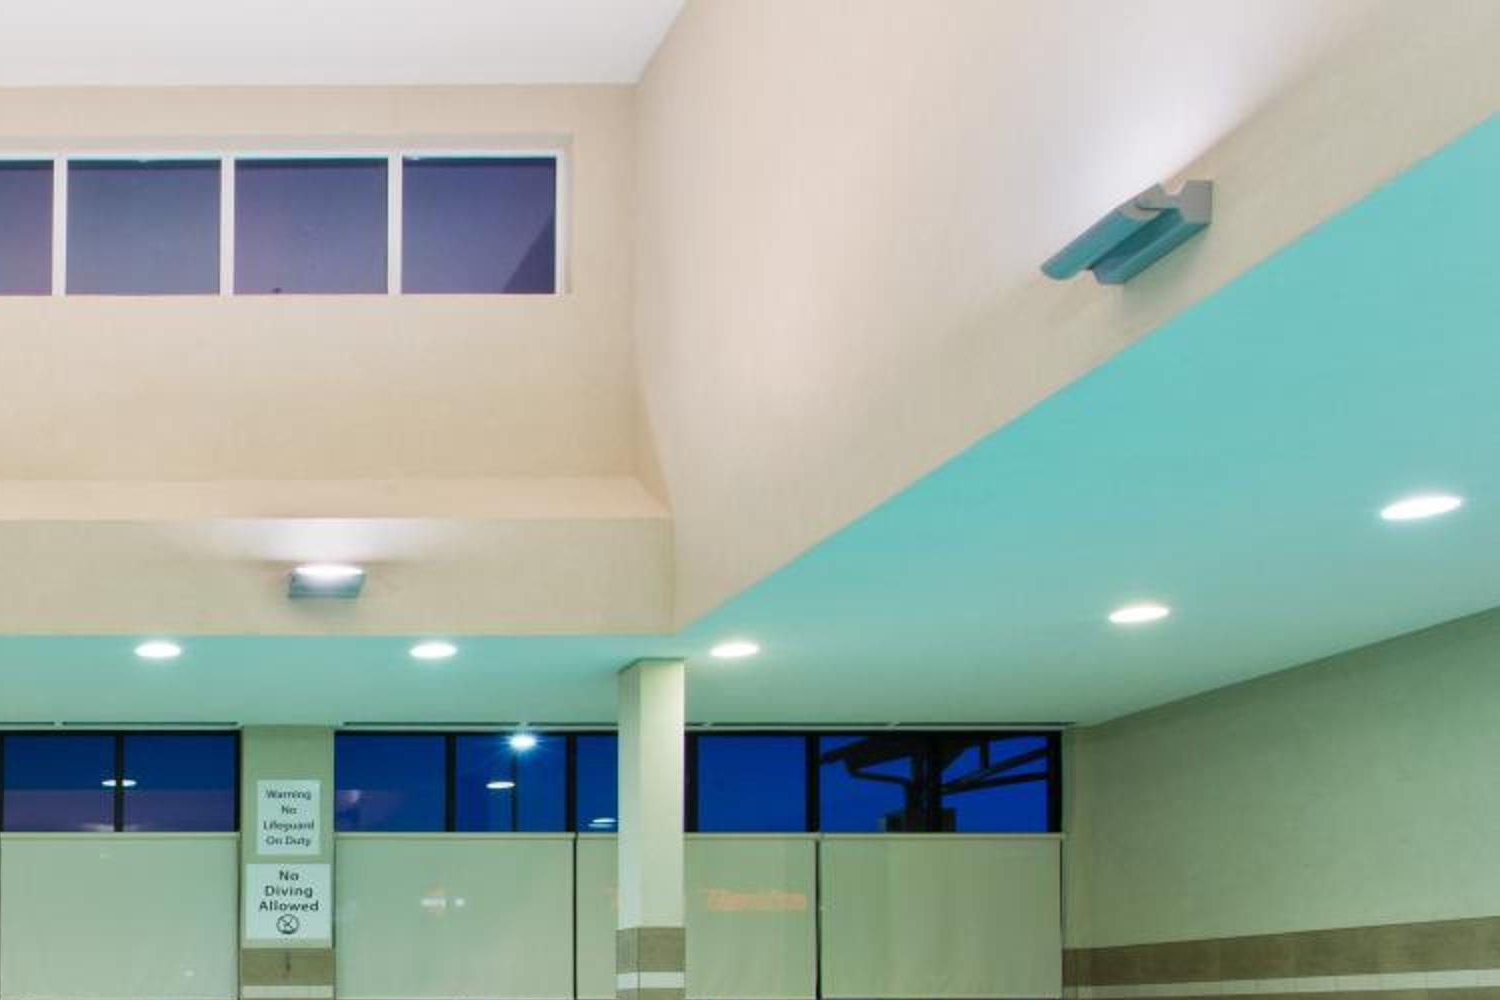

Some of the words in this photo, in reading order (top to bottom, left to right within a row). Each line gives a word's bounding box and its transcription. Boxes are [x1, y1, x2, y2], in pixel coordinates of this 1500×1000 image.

[265, 789, 312, 801] Warning
[281, 805, 297, 815] No
[263, 819, 315, 833] Lifeguard
[266, 835, 283, 846] On
[285, 835, 312, 847] Duty
[279, 869, 300, 881] No
[265, 885, 313, 899] Diving
[259, 899, 319, 912] Allowed
